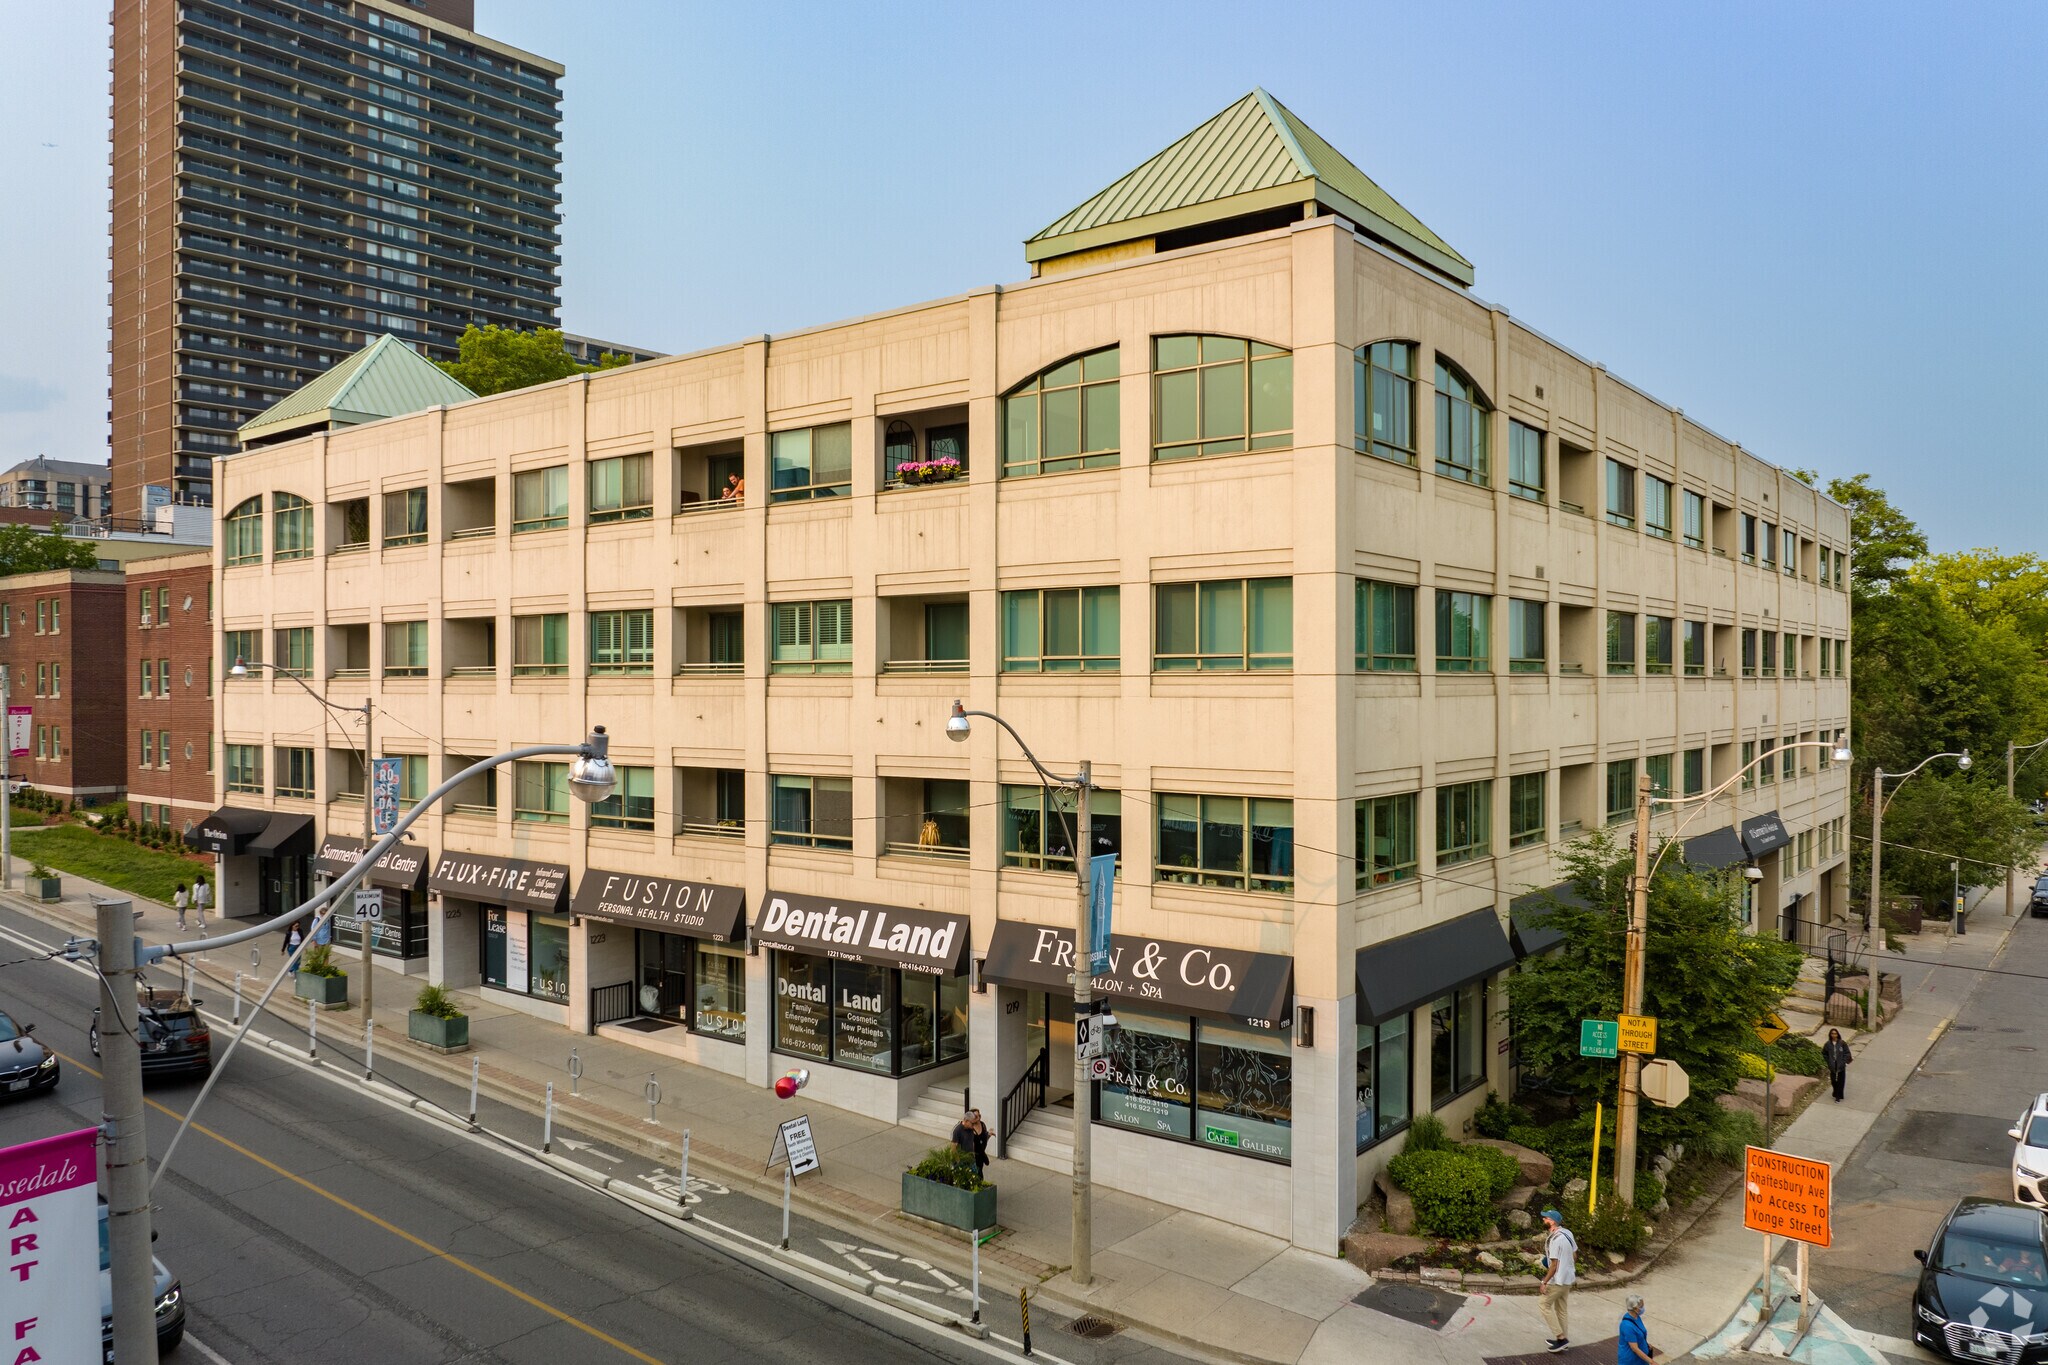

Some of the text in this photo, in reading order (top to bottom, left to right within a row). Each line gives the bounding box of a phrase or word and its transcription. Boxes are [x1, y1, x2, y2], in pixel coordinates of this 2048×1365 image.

[320, 844, 364, 864] Summerhil
[391, 854, 418, 873] Centre
[602, 876, 714, 913] FUSION
[356, 903, 380, 918] 40
[445, 909, 461, 919] 1225
[488, 909, 499, 921] For
[598, 902, 705, 927] PERSONAL HEALTH STUDIO
[384, 927, 402, 939] Centre
[488, 920, 506, 934] Lease
[762, 898, 958, 959] Dental Land
[590, 933, 606, 944] 1223
[712, 934, 724, 942] 1223
[758, 939, 795, 951] Dentalland.ca
[827, 950, 863, 962] 1221 Yonge St.
[1029, 928, 1124, 975] FRN
[1132, 942, 1167, 981] &
[1090, 977, 1124, 992] ALON
[778, 977, 882, 1013] Dental Land
[791, 1002, 812, 1014] Family
[1006, 1001, 1020, 1014] 1219
[785, 1011, 819, 1026] Emergency
[847, 1012, 878, 1026] Cosmetic
[1247, 1017, 1271, 1029] 1219
[1627, 1019, 1641, 1027] NOT
[789, 1023, 815, 1035] Walk-ins
[841, 1022, 884, 1038] New Patients
[1592, 1031, 1608, 1039] ACCESS
[1621, 1028, 1653, 1039] THROUGH
[782, 1037, 823, 1052] 416-672-1000
[847, 1035, 878, 1048] Welcome
[1623, 1040, 1649, 1049] STREET
[840, 1048, 885, 1065] Dentalland.ca
[1107, 1067, 1143, 1087] FRAN
[1147, 1074, 1159, 1090] &
[1124, 1095, 1169, 1109] 416.920.3110
[1124, 1101, 1169, 1116] 416.922.1219
[1114, 1110, 1140, 1125] SALON
[783, 1122, 797, 1131] Dental
[1157, 1119, 1172, 1132] SPA
[789, 1129, 806, 1141] FREE
[1242, 1138, 1284, 1155] GALLERY
[1751, 1154, 1824, 1180] CONSTRUCTION
[1750, 1171, 1825, 1199] Shaftesbury Ave
[1748, 1190, 1826, 1219] No Access To
[1752, 1208, 1822, 1236] Yonge Street
[8, 1206, 39, 1282] ART
